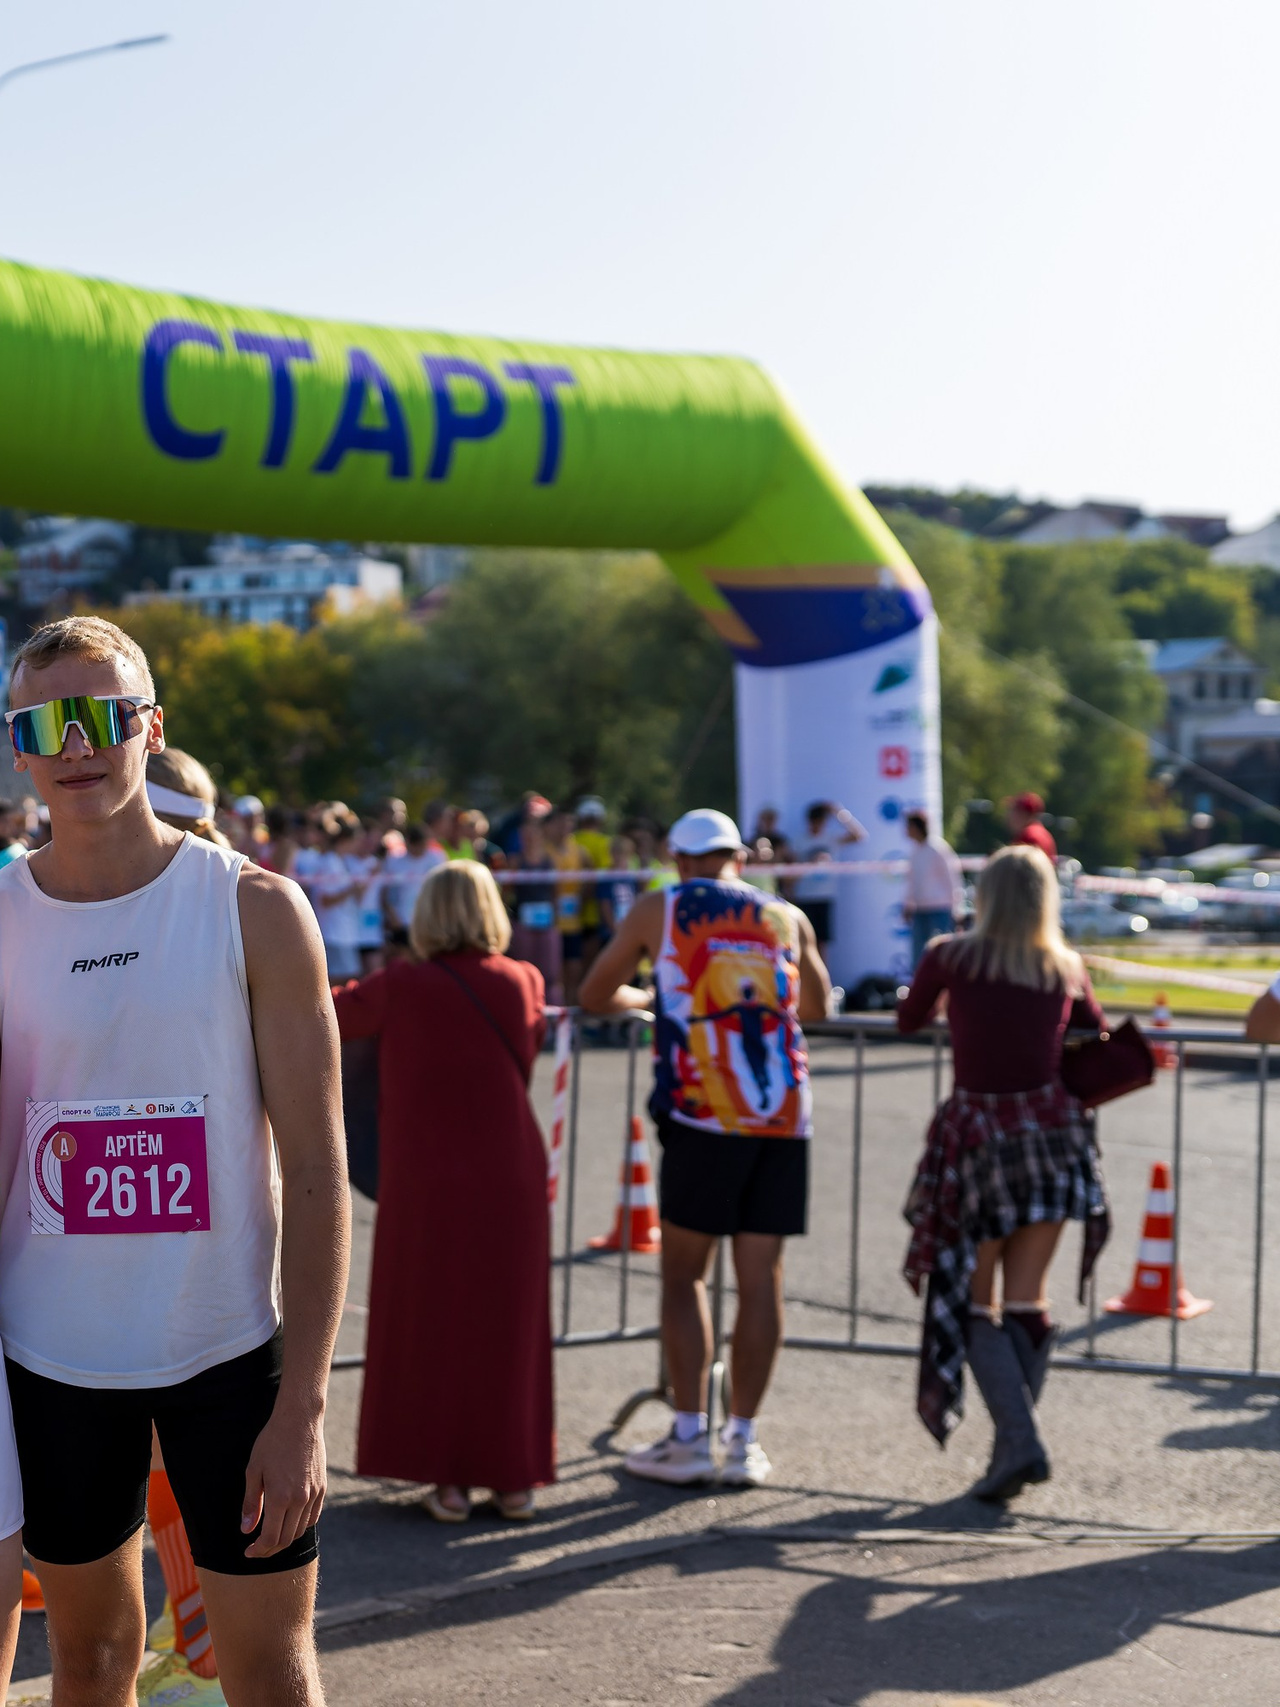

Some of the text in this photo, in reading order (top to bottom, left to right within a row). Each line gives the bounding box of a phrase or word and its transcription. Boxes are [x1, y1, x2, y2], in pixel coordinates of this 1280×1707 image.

[141, 318, 576, 486] СТАРТ
[71, 951, 139, 973] AMRP
[158, 1103, 175, 1113] Пэй
[60, 1138, 69, 1156] А
[105, 1130, 163, 1157] АРТЁМ
[85, 1162, 192, 1217] 2612
